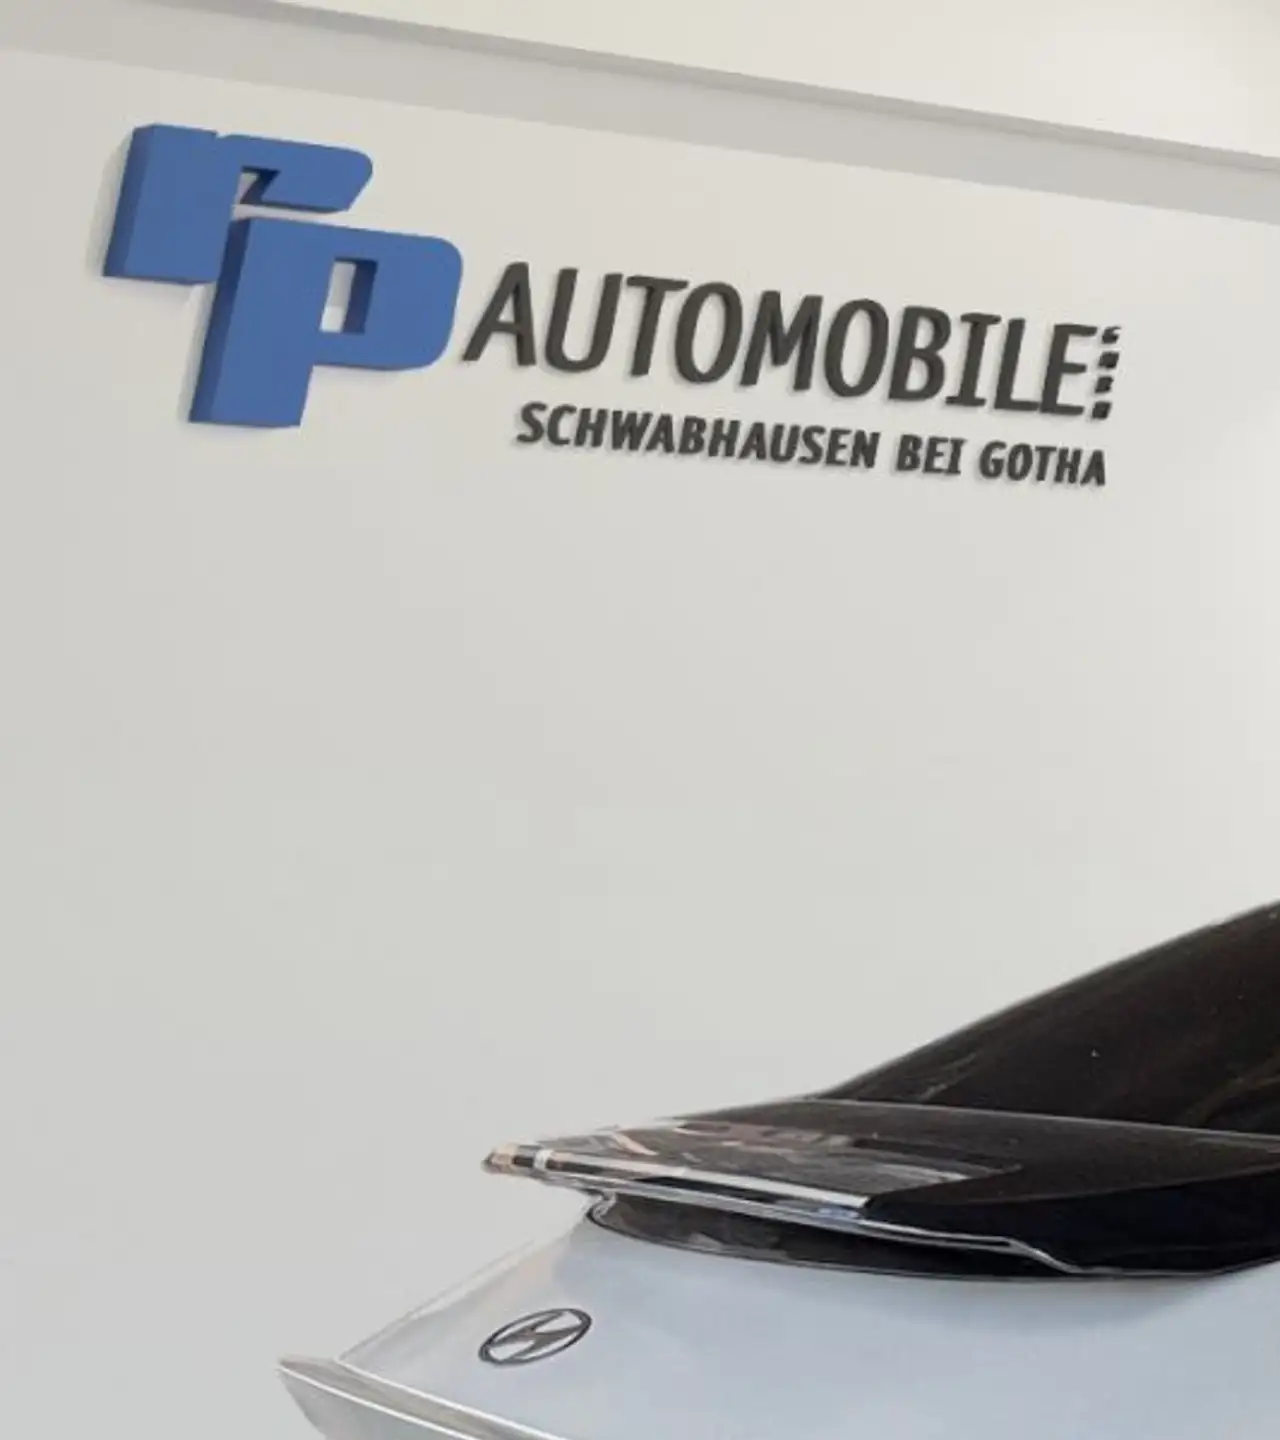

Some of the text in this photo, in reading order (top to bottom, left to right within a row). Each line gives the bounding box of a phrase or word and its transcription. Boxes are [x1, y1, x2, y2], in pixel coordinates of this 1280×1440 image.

[461, 262, 1099, 417] AUTOMOBILE
[516, 402, 1107, 488] SCHWABHAUSEN BEI GOTHA
